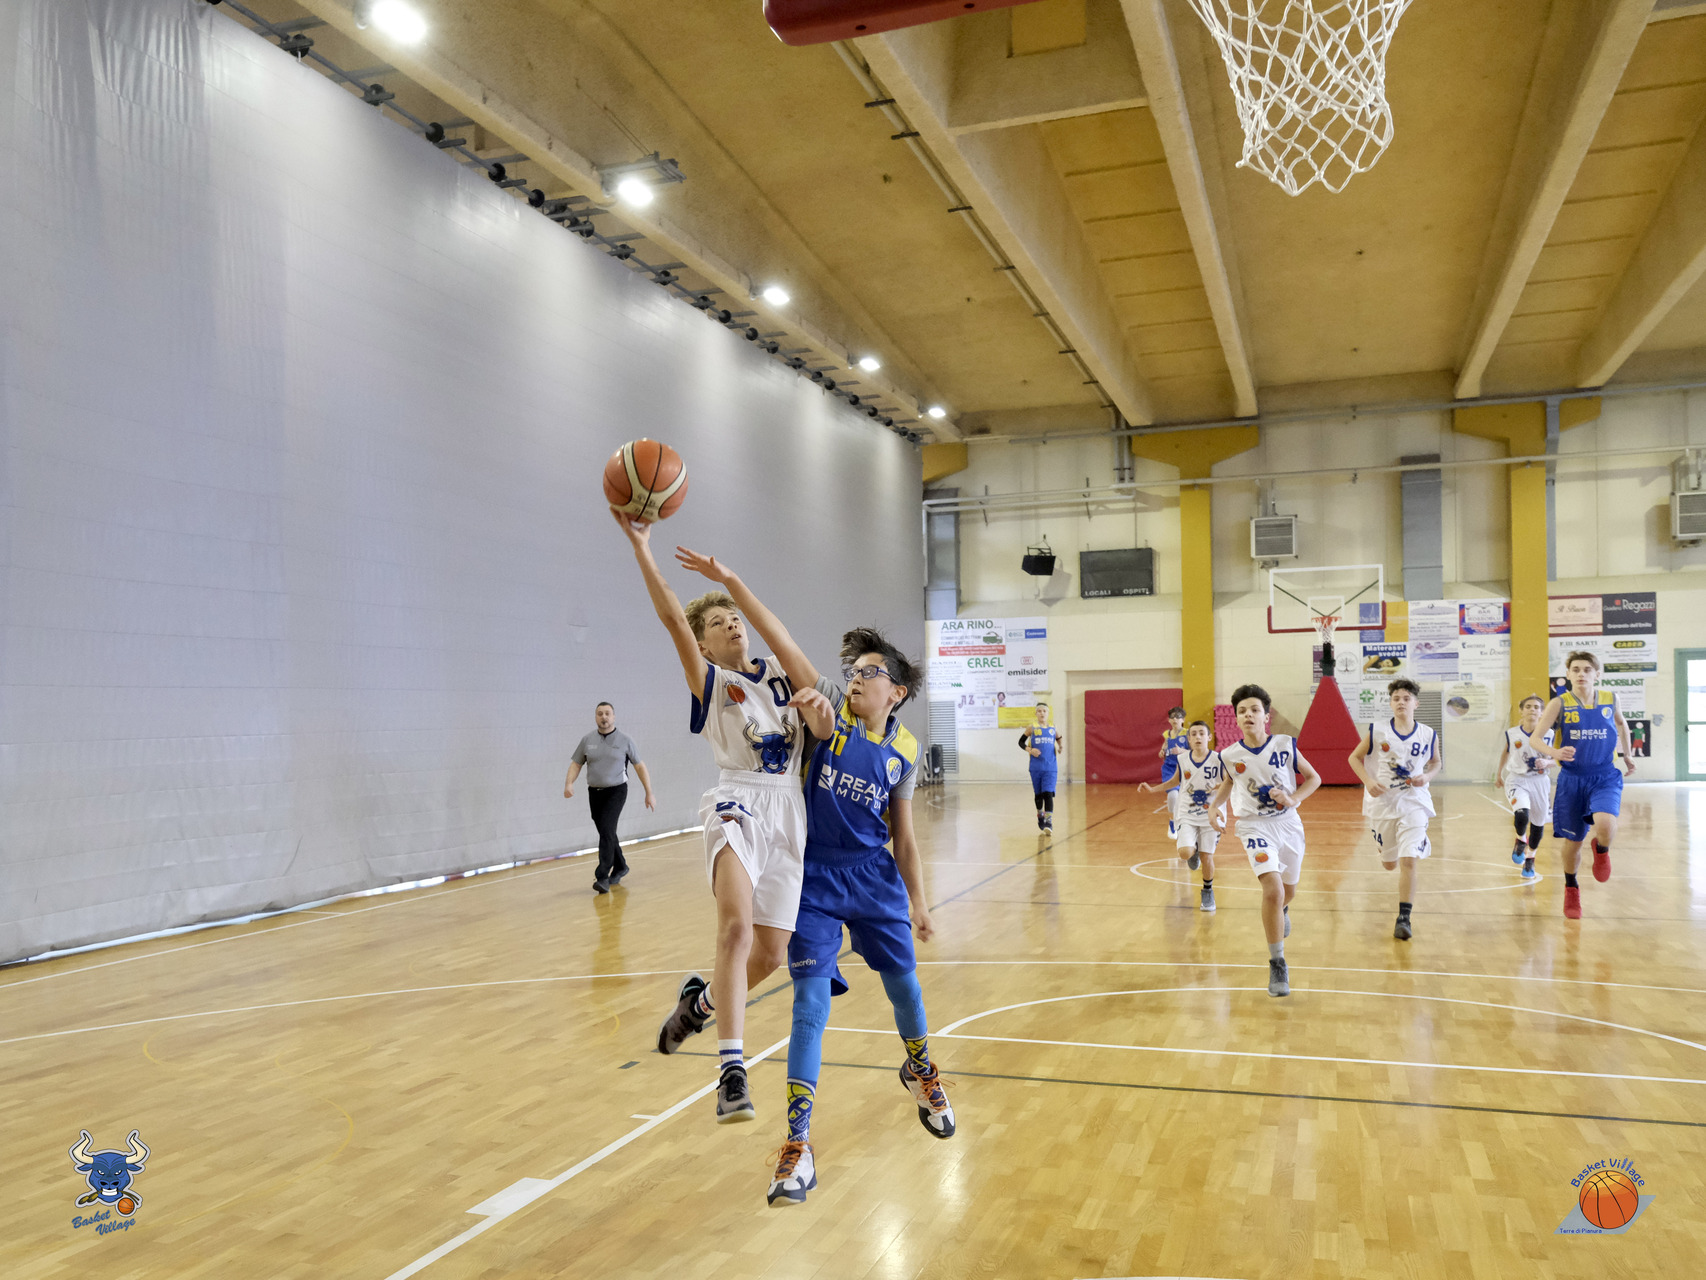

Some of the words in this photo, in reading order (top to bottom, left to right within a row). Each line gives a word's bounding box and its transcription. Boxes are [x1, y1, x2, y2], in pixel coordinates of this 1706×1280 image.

[1123, 587, 1149, 595] OSPITI
[941, 621, 964, 630] ARA
[967, 620, 993, 629] RINO
[967, 657, 1004, 668] ERREL
[1008, 668, 1047, 676] emilsider
[1564, 711, 1580, 724] 26
[1268, 751, 1289, 768] 40
[1204, 767, 1218, 780] 50
[839, 772, 889, 801] REALE
